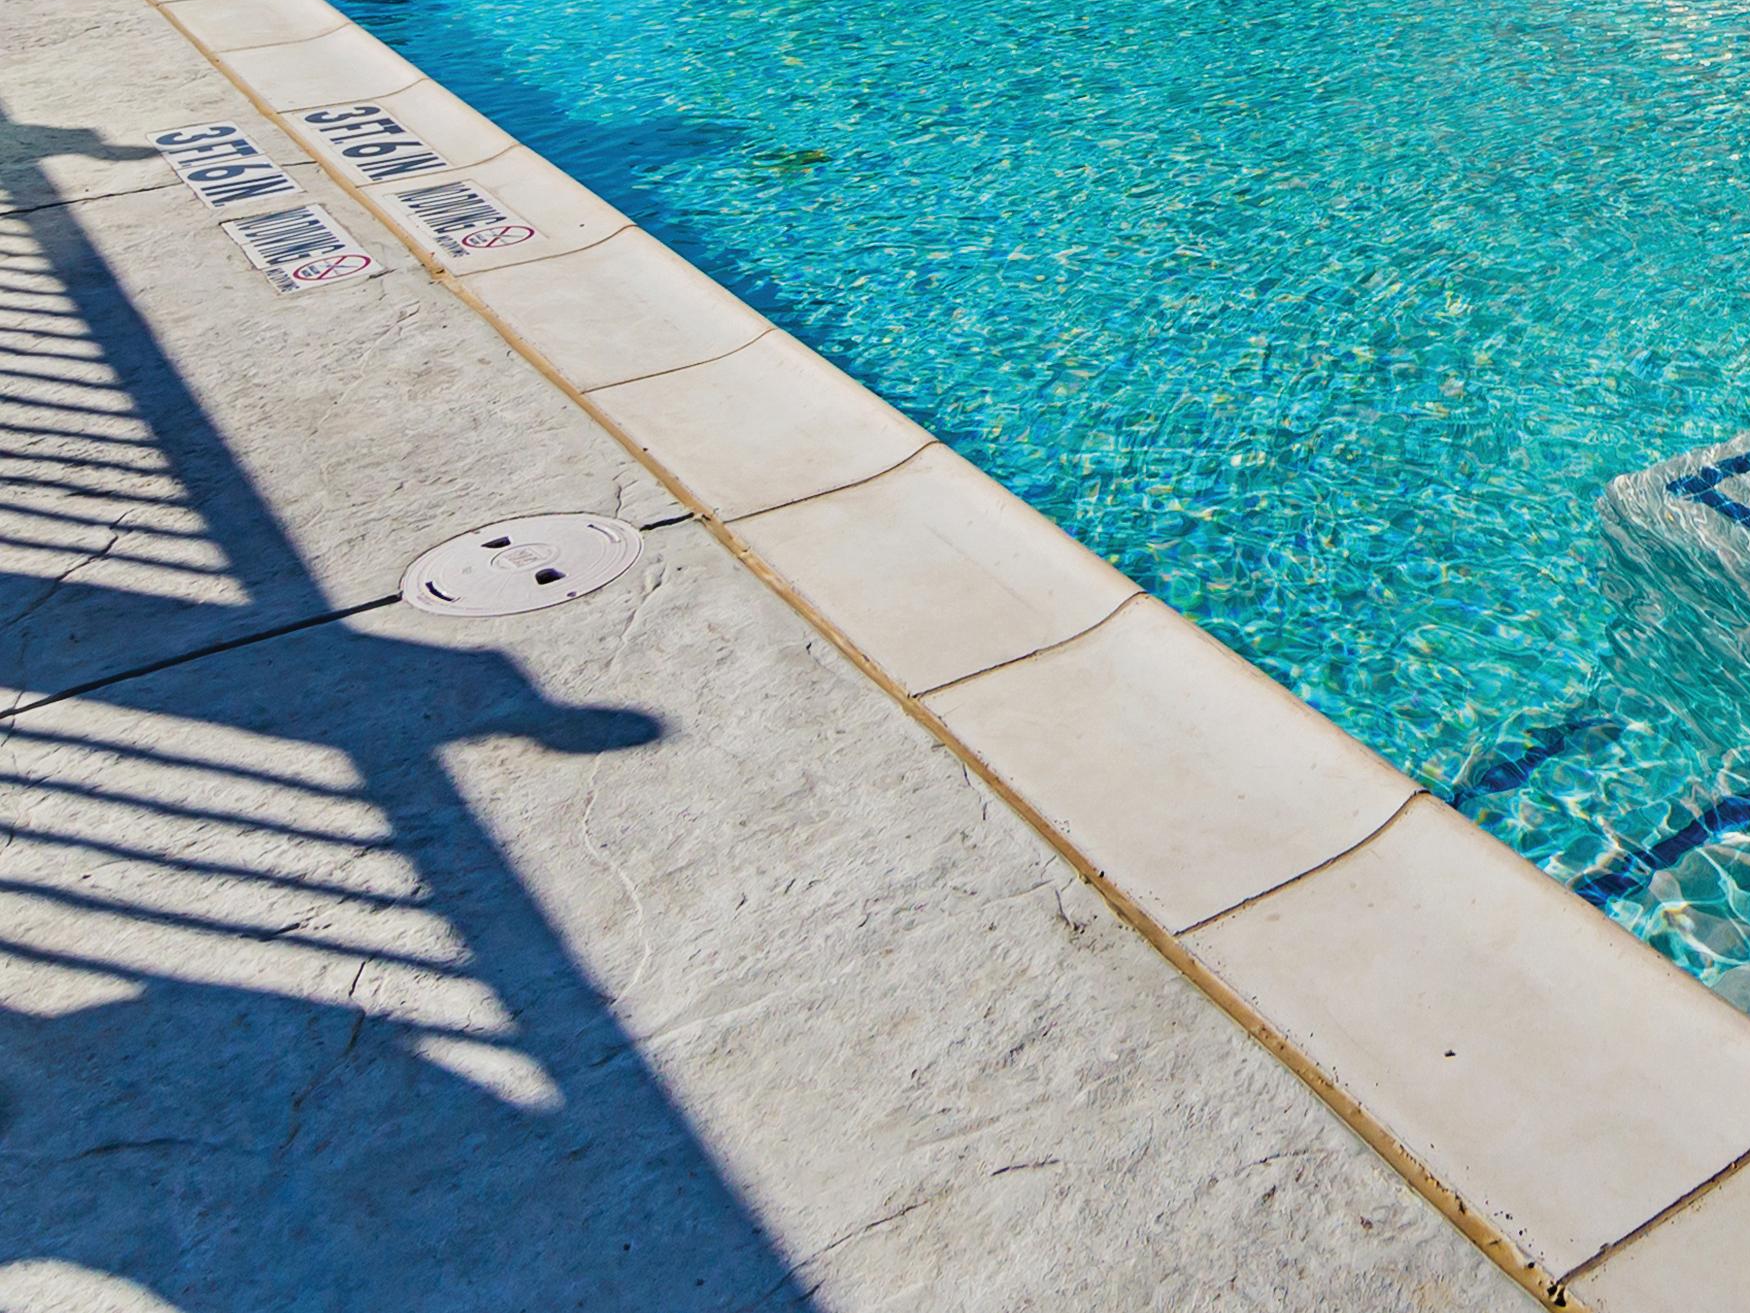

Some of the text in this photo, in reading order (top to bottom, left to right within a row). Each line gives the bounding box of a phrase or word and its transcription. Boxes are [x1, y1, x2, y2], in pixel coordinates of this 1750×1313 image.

[304, 106, 381, 123] 3
[155, 126, 237, 145] 3
[319, 117, 407, 145] FT.
[167, 138, 258, 168] FT.
[341, 141, 424, 158] 6
[187, 163, 273, 181] 6
[394, 181, 507, 234] NO DIVING
[234, 206, 346, 265] NO DIVING
